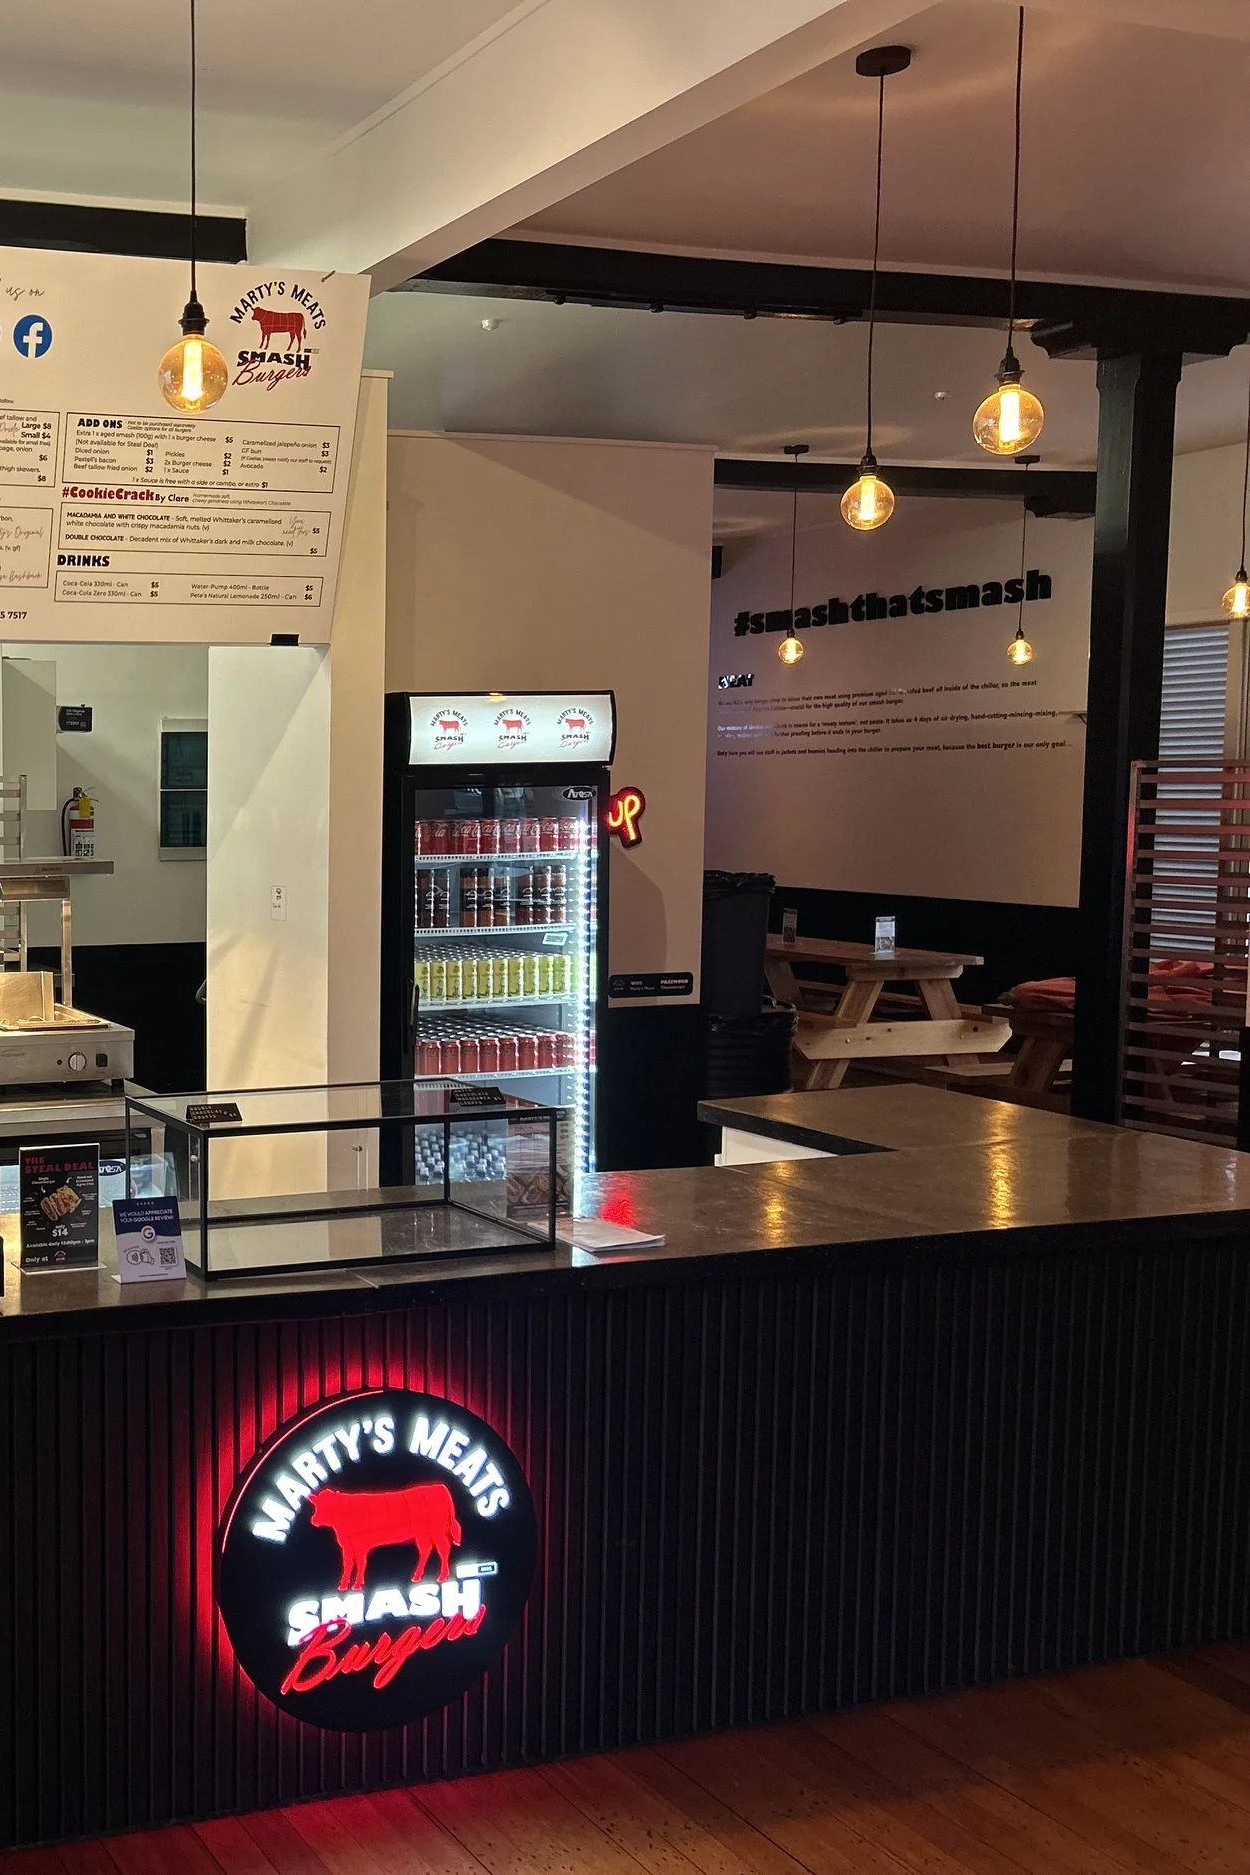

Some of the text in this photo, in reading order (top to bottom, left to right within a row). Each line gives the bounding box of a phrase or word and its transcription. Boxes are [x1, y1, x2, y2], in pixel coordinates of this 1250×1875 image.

[230, 281, 327, 330] MARTY'S MEATS
[237, 350, 311, 370] SMASH
[231, 361, 312, 391] Burgers
[78, 418, 123, 429] ADD ONS
[62, 486, 189, 504] #CookieCrack By Clare
[57, 554, 110, 567] DRINKS
[7, 611, 27, 620] 7517
[733, 570, 1052, 637] #smashthatsmash
[251, 1416, 511, 1544] MARTY'S MEATS
[287, 1578, 481, 1648] SMASH
[280, 1604, 487, 1695] Burgers
